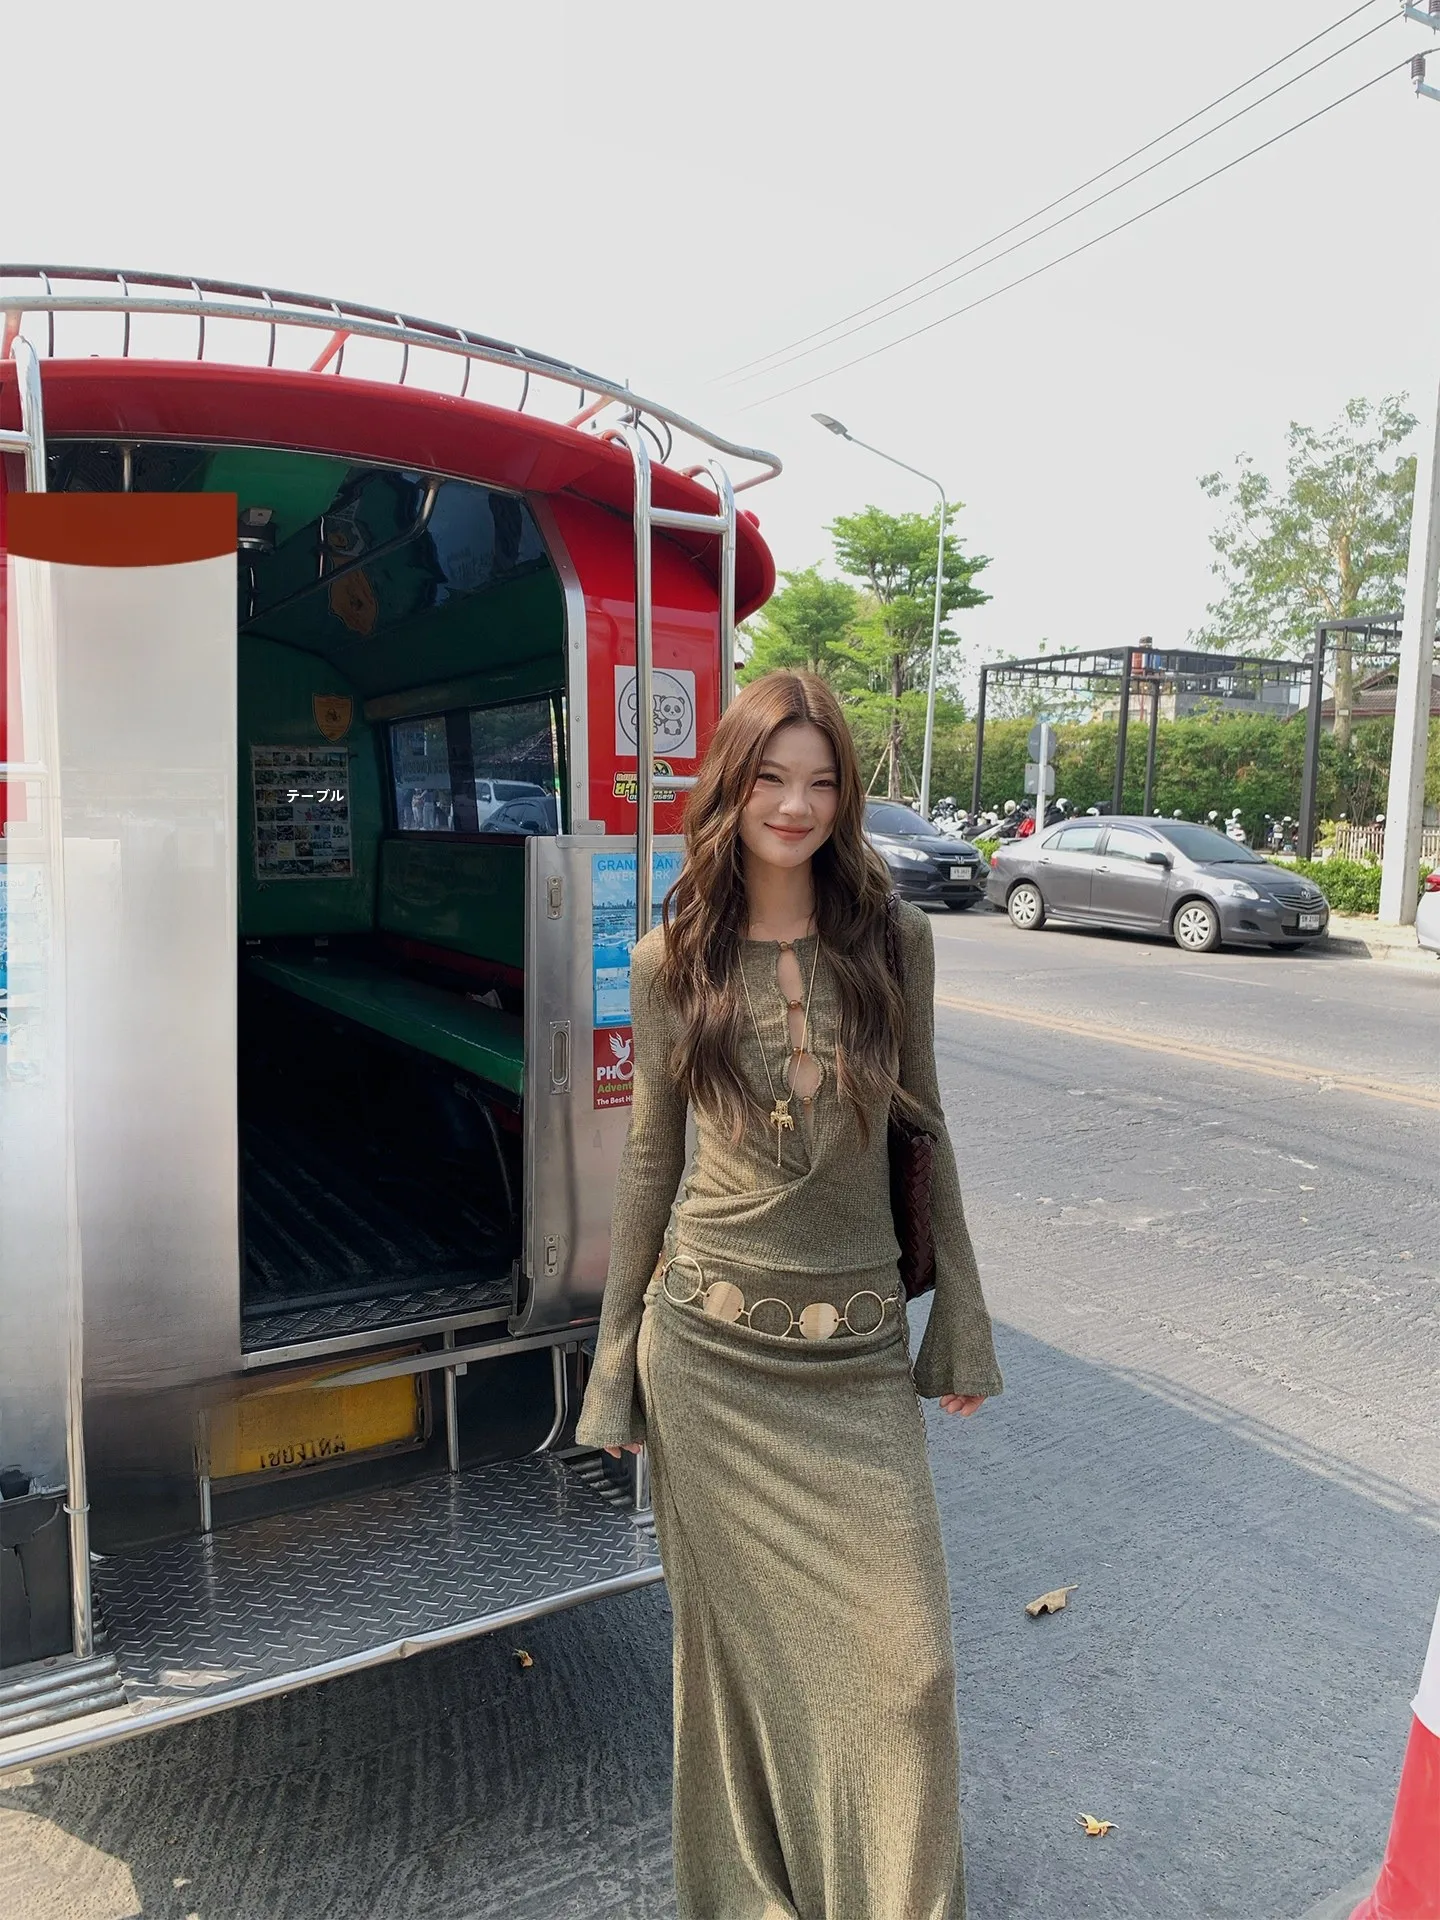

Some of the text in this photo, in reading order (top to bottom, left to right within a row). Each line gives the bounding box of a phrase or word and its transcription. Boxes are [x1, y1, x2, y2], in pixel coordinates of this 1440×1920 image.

[597, 859, 637, 871] GRAN
[597, 1098, 610, 1106] The
[610, 1096, 625, 1104] Best
